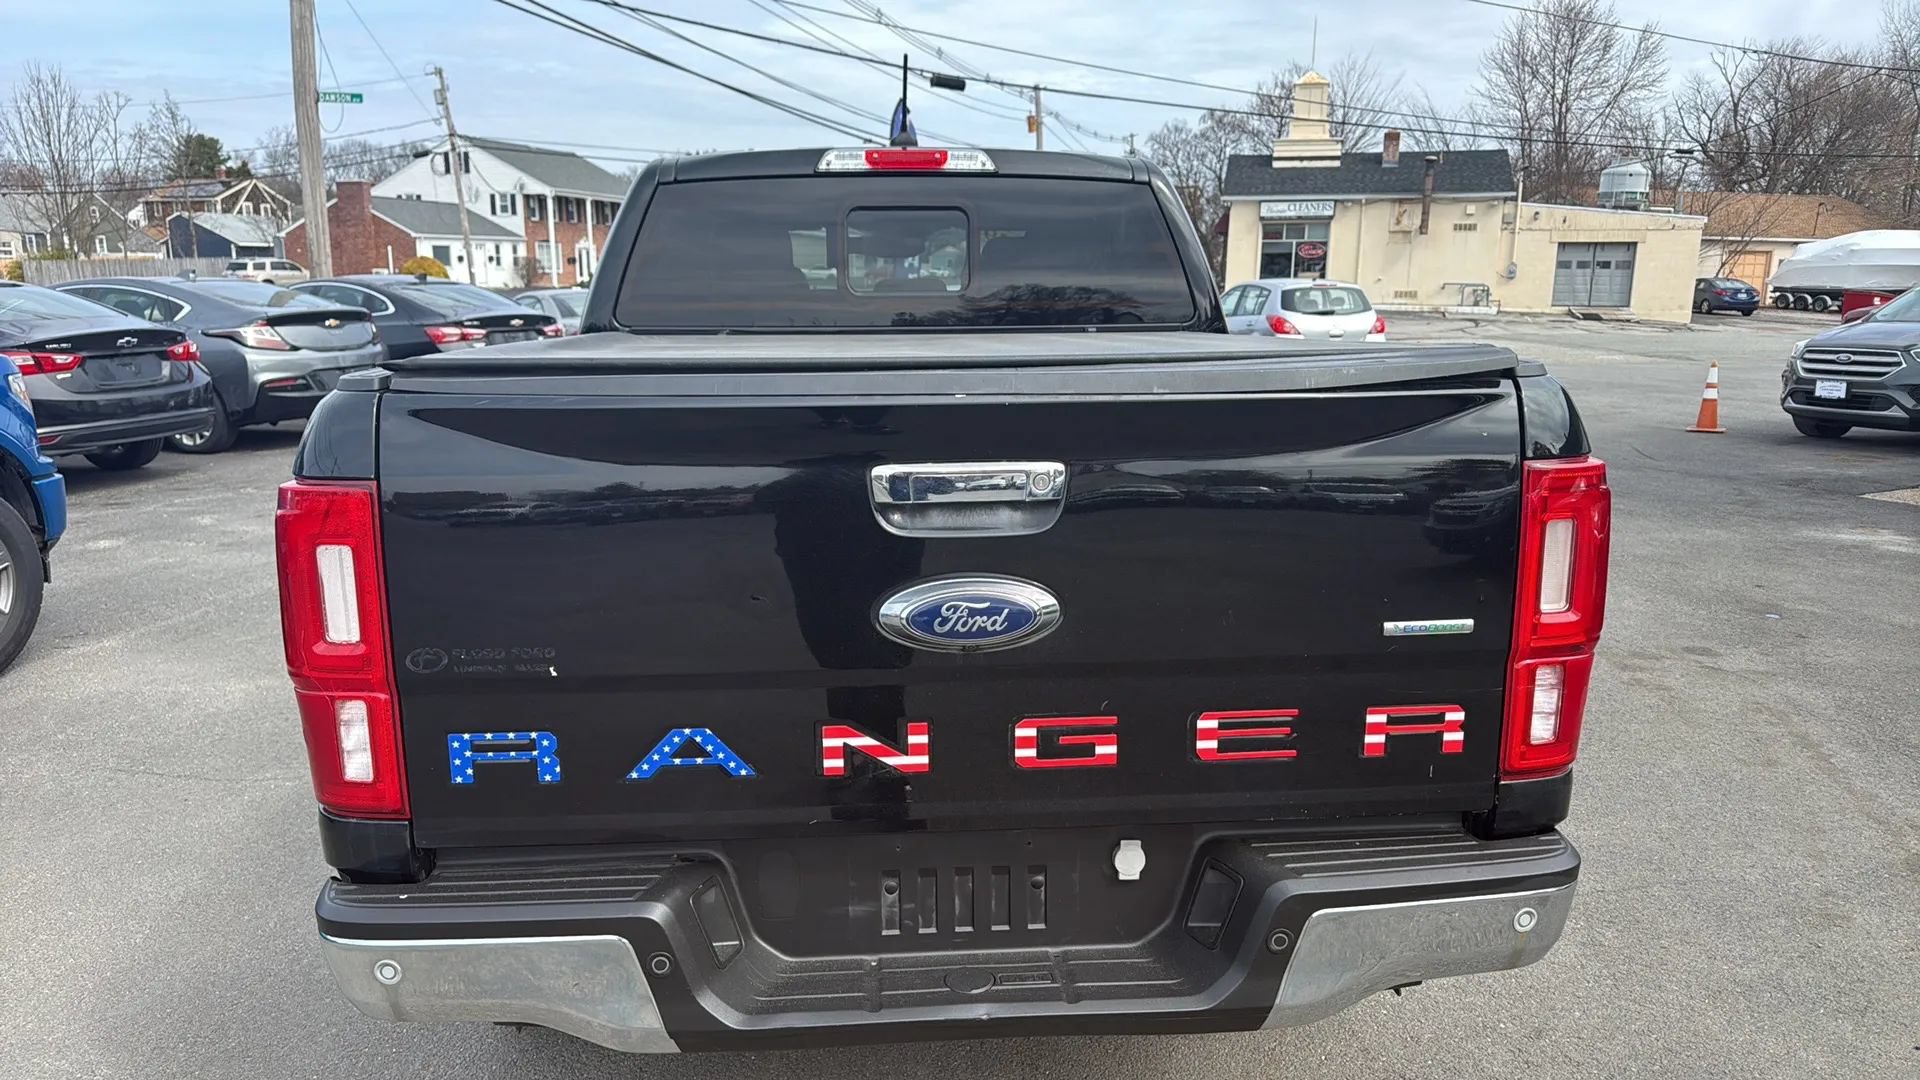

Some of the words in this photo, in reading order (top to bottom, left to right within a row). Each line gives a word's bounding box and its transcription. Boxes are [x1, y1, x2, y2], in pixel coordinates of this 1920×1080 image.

[1287, 202, 1333, 213] CLEANERS
[933, 601, 1010, 634] Ford
[511, 647, 556, 659] FORD
[447, 704, 1466, 785] RANGER
